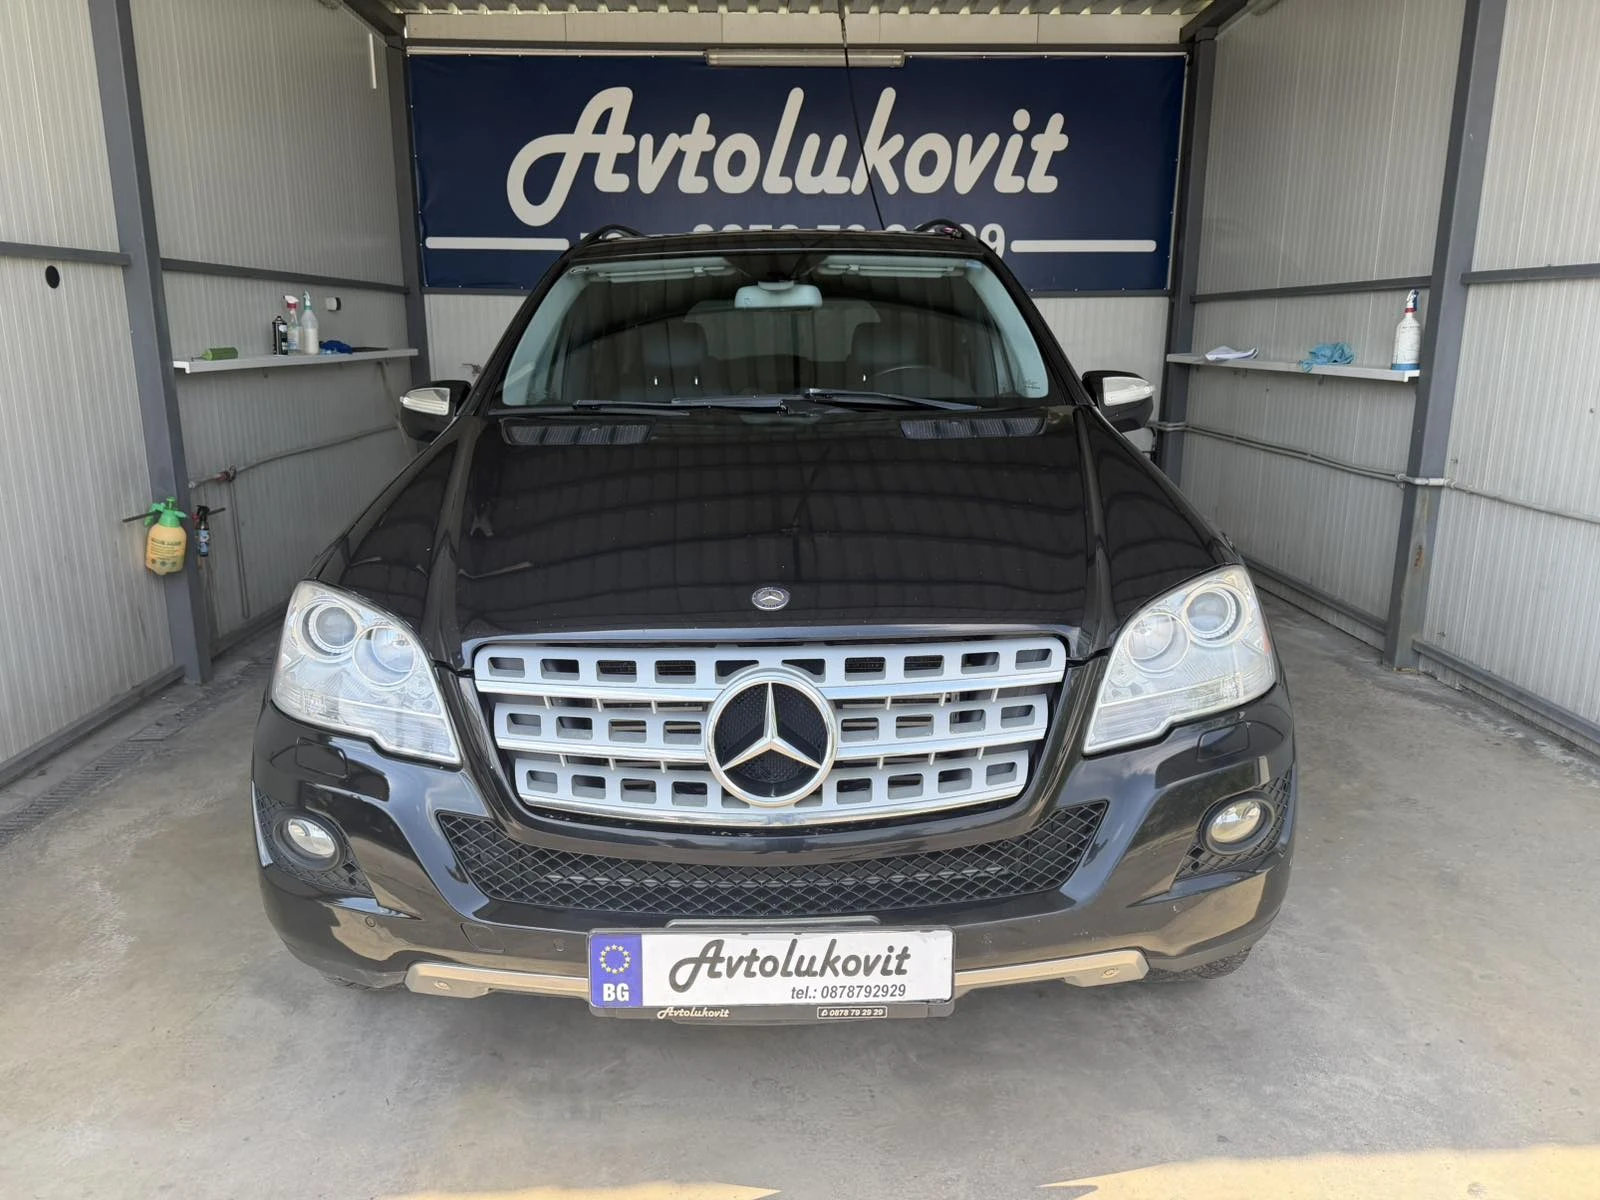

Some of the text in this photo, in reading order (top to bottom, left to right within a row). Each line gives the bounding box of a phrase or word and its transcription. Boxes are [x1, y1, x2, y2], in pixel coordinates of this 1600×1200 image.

[507, 86, 1069, 227] Avtolukovit
[669, 938, 911, 993] Avtolukovit
[602, 983, 630, 1002] BG
[791, 984, 906, 999] tel.: 0878792929
[657, 1006, 730, 1019] Avtolukovit
